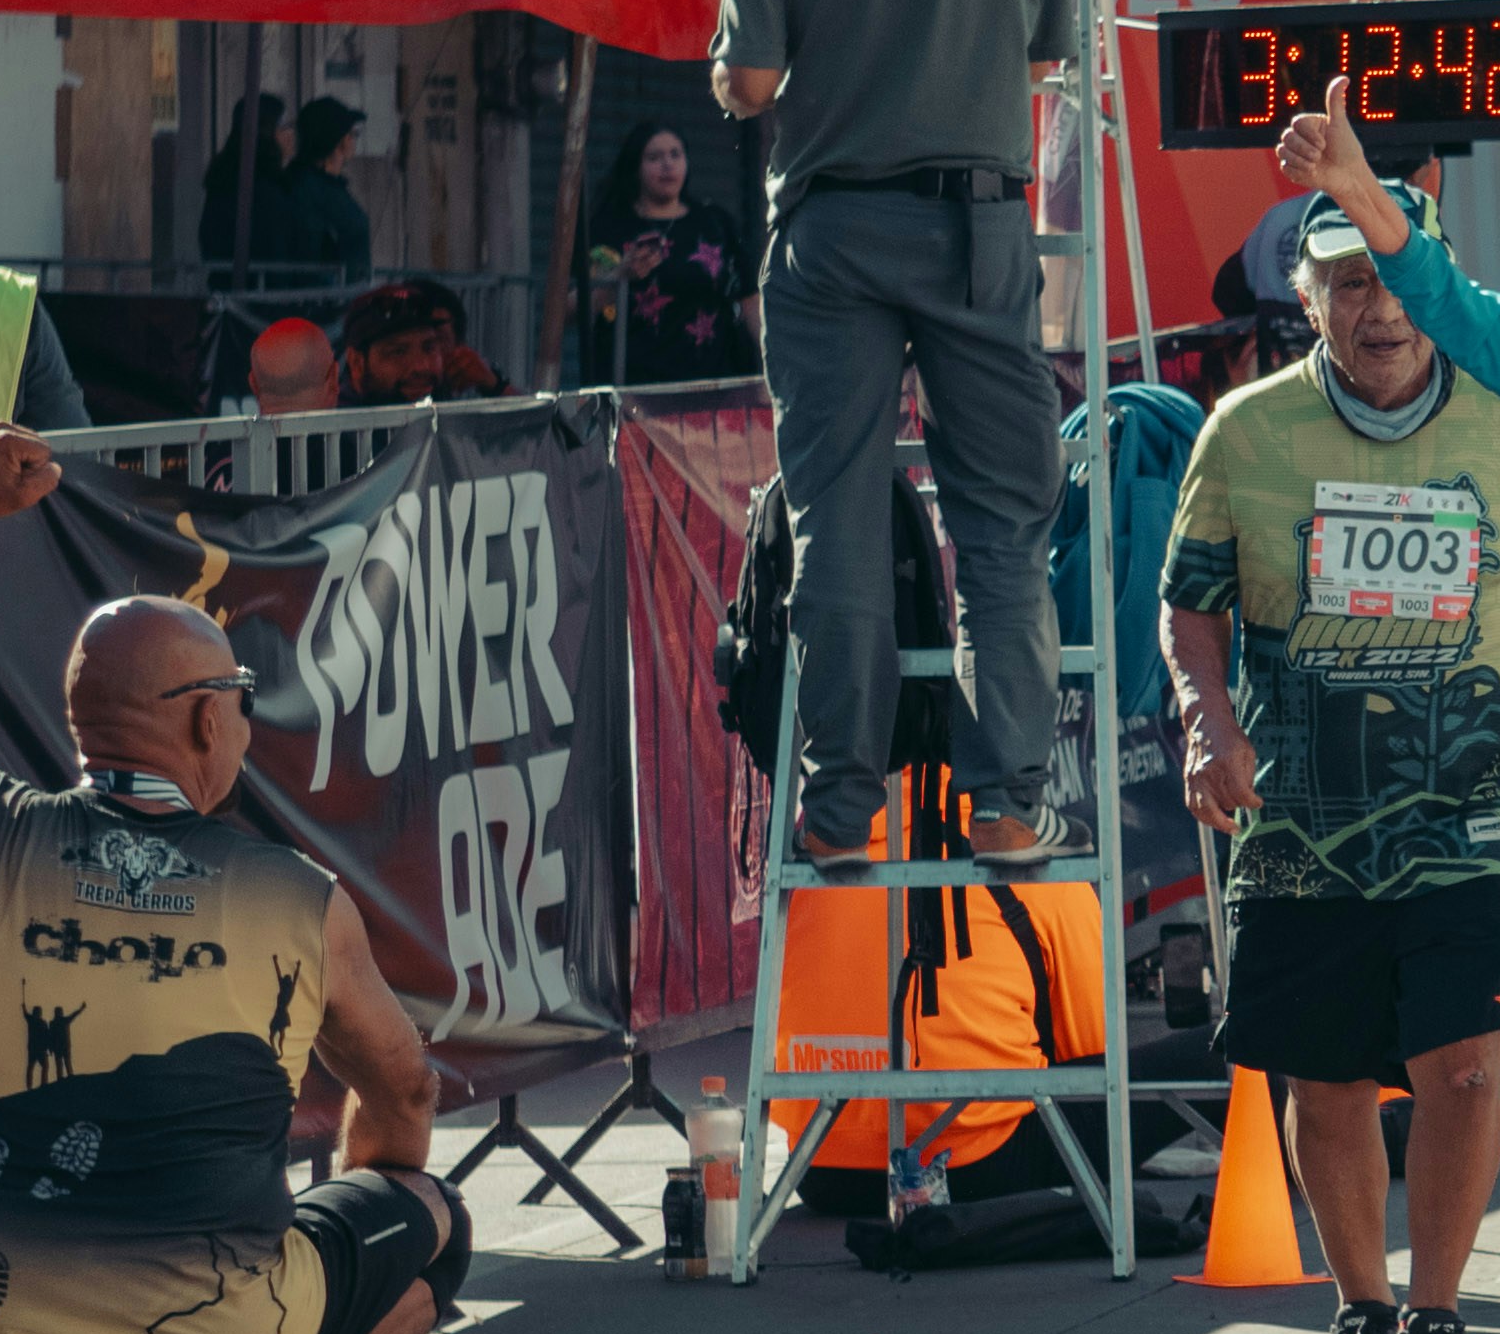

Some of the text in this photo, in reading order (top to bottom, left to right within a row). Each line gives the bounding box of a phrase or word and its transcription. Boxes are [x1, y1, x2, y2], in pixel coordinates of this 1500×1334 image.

[1342, 525, 1461, 575] 1003
[1317, 594, 1346, 608] 1003
[1400, 598, 1430, 612] 1003
[300, 471, 573, 793] POWER
[1361, 647, 1460, 666] 2022
[76, 880, 196, 913] TREPA CERROS
[432, 750, 573, 1044] ADE
